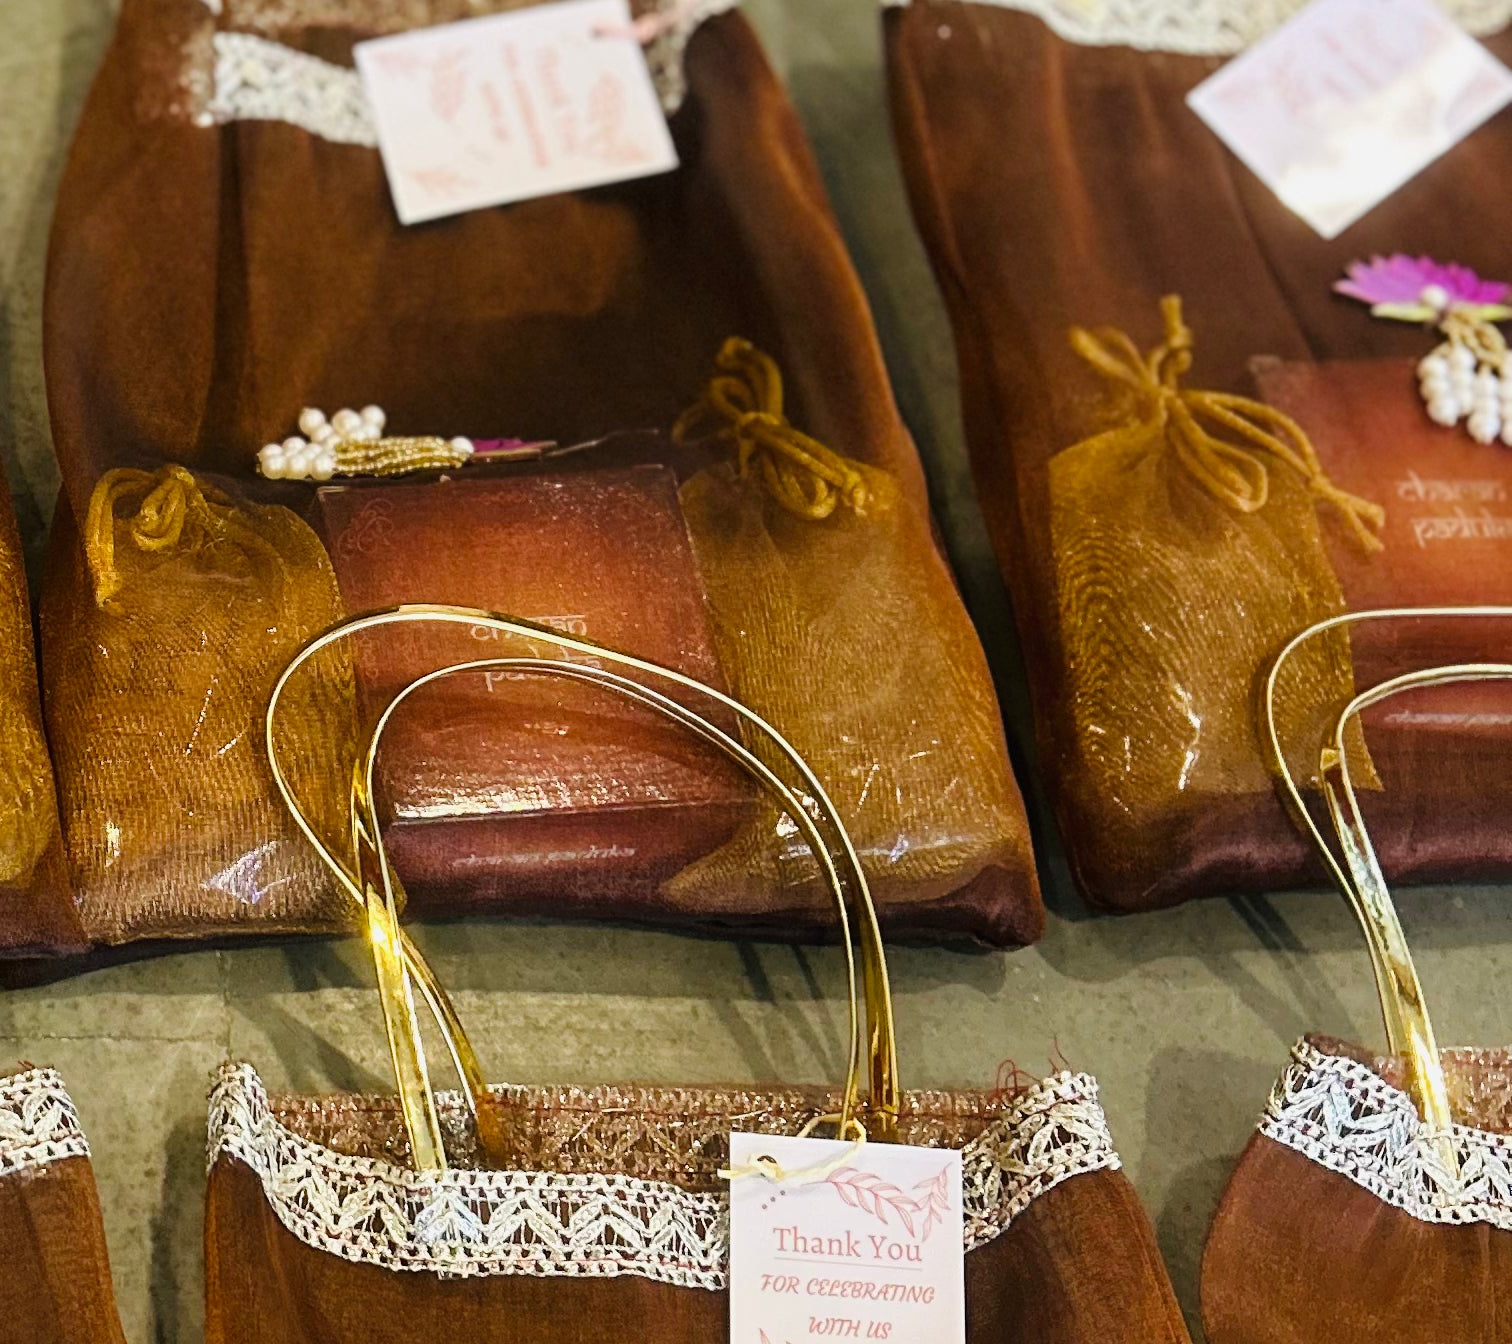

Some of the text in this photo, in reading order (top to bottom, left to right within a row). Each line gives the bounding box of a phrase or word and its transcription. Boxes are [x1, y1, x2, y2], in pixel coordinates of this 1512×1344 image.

[773, 1225, 923, 1262] Thank You
[760, 1274, 936, 1305] FOR CELEBRATING
[808, 1316, 894, 1341] WITH US
